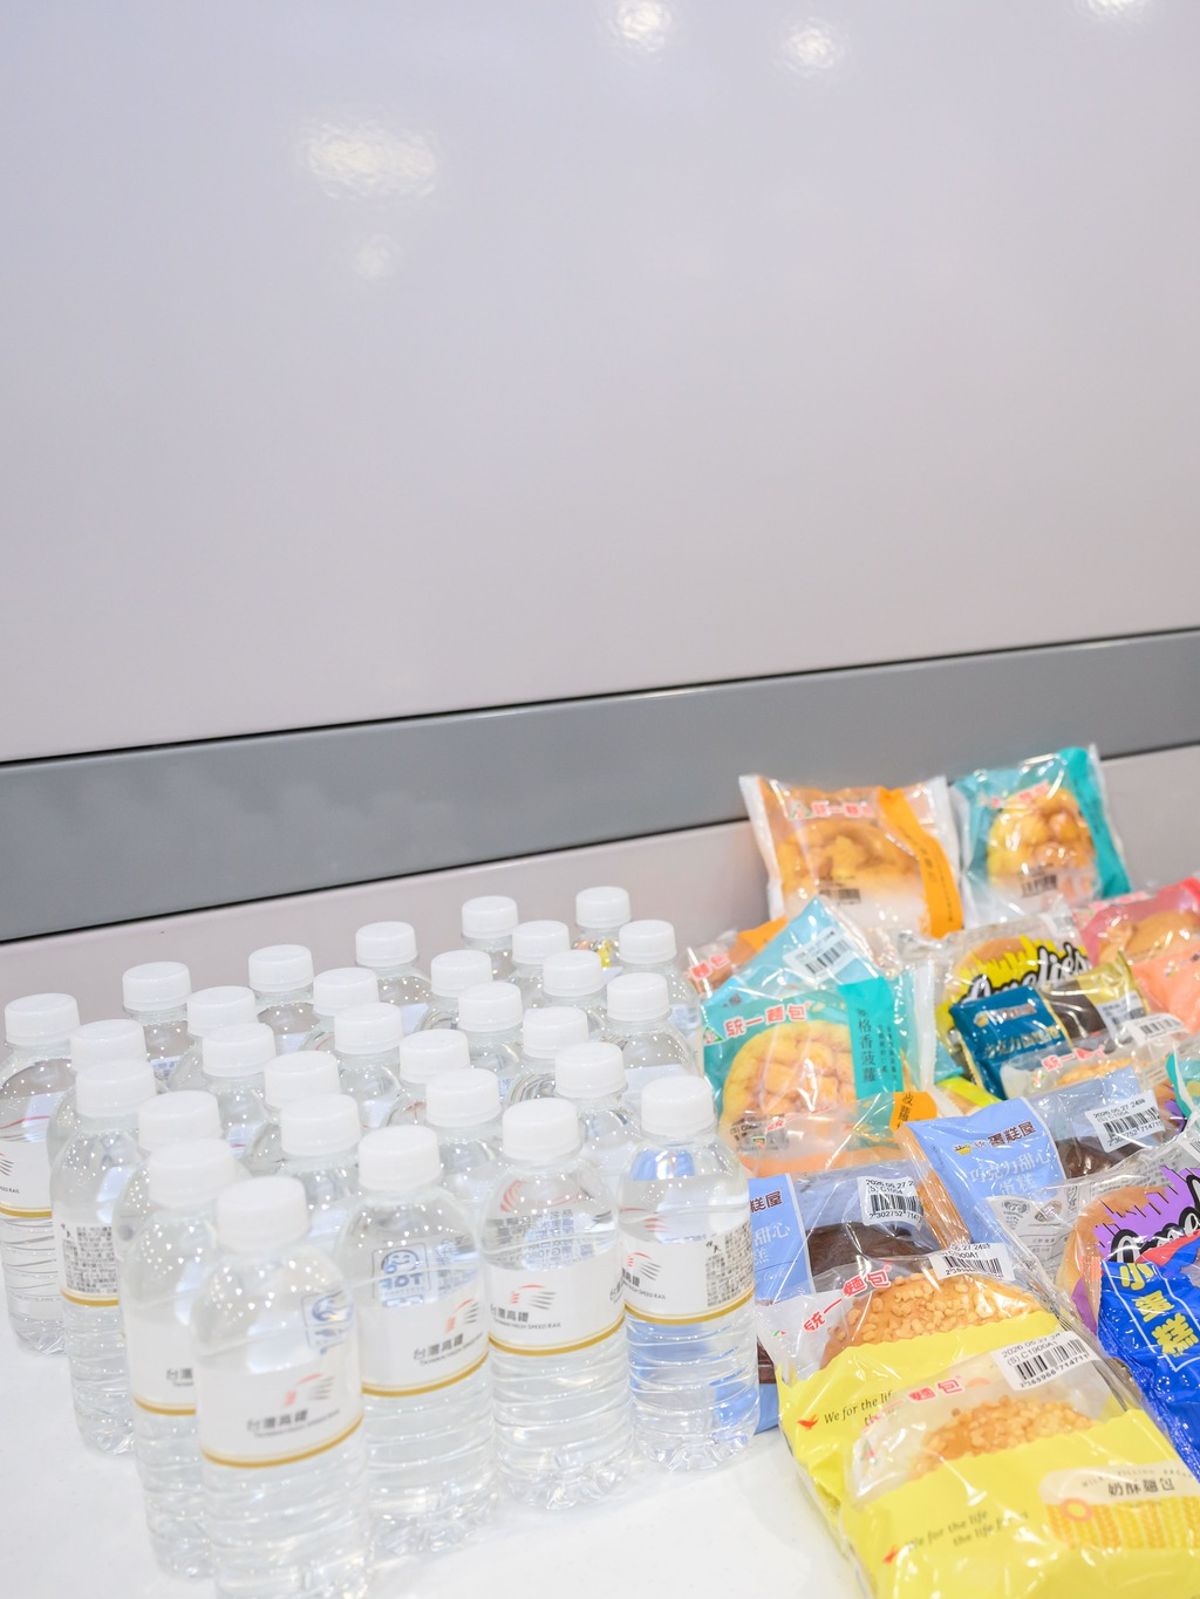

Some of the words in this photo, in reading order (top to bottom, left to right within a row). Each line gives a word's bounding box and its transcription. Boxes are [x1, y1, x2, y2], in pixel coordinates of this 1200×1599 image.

[724, 1003, 806, 1037] 統一麵包
[988, 1120, 1036, 1147] 蛋糕屋
[803, 1270, 891, 1332] 統一麵包
[1119, 1262, 1200, 1358] 小蛋糕
[824, 1411, 841, 1425] We
[842, 1405, 858, 1421] for
[860, 1398, 878, 1411] the
[948, 1520, 967, 1533] the
